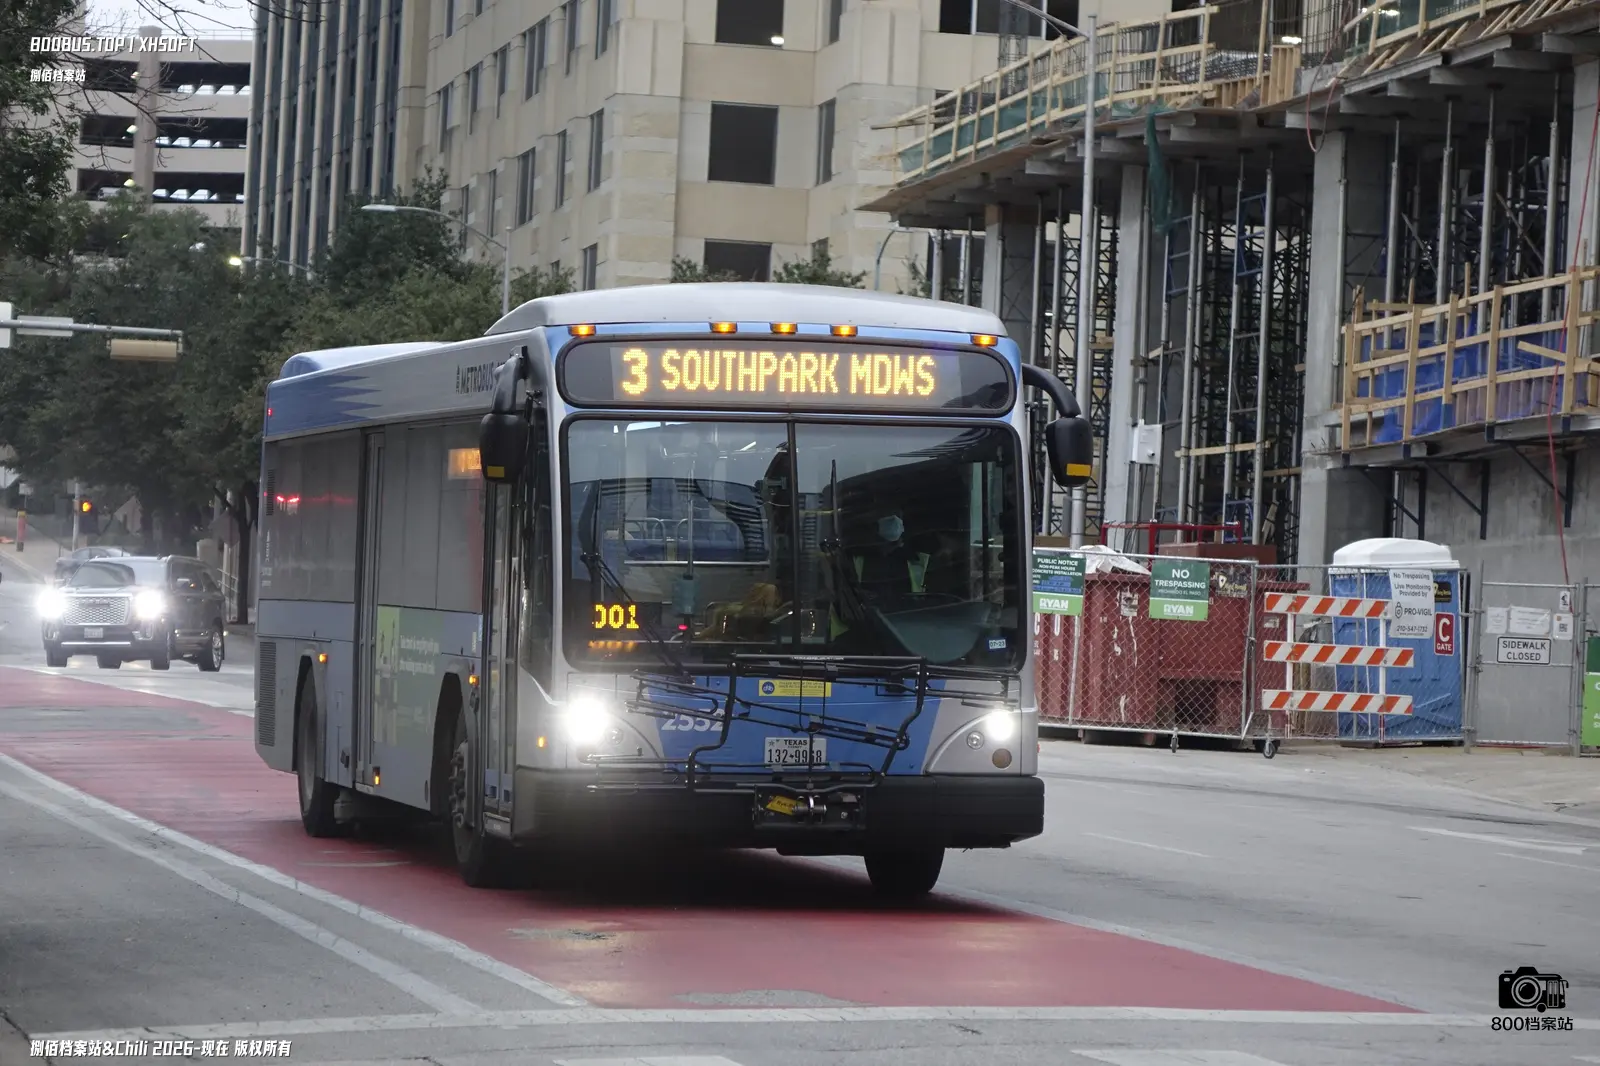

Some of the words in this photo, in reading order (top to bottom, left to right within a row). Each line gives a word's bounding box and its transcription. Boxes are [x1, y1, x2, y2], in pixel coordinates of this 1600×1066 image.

[622, 348, 648, 395] 3
[661, 350, 839, 393] SOUTHPARK
[850, 353, 936, 396] MDWS
[1037, 557, 1057, 565] PUBLIC
[1058, 559, 1079, 567] NOTICE
[1171, 568, 1190, 579] NO
[1402, 572, 1430, 581] Trespassing
[1154, 579, 1207, 589] TRESPASSING
[1405, 584, 1432, 592] Monitoring
[1040, 598, 1069, 609] RYAN
[1163, 604, 1194, 614] RYAN
[1403, 607, 1433, 617] PRO-VIGIL
[1438, 617, 1451, 643] C
[1436, 643, 1453, 651] GATE
[1502, 640, 1547, 650] SIDEWALK
[1506, 651, 1542, 661] CLOSED
